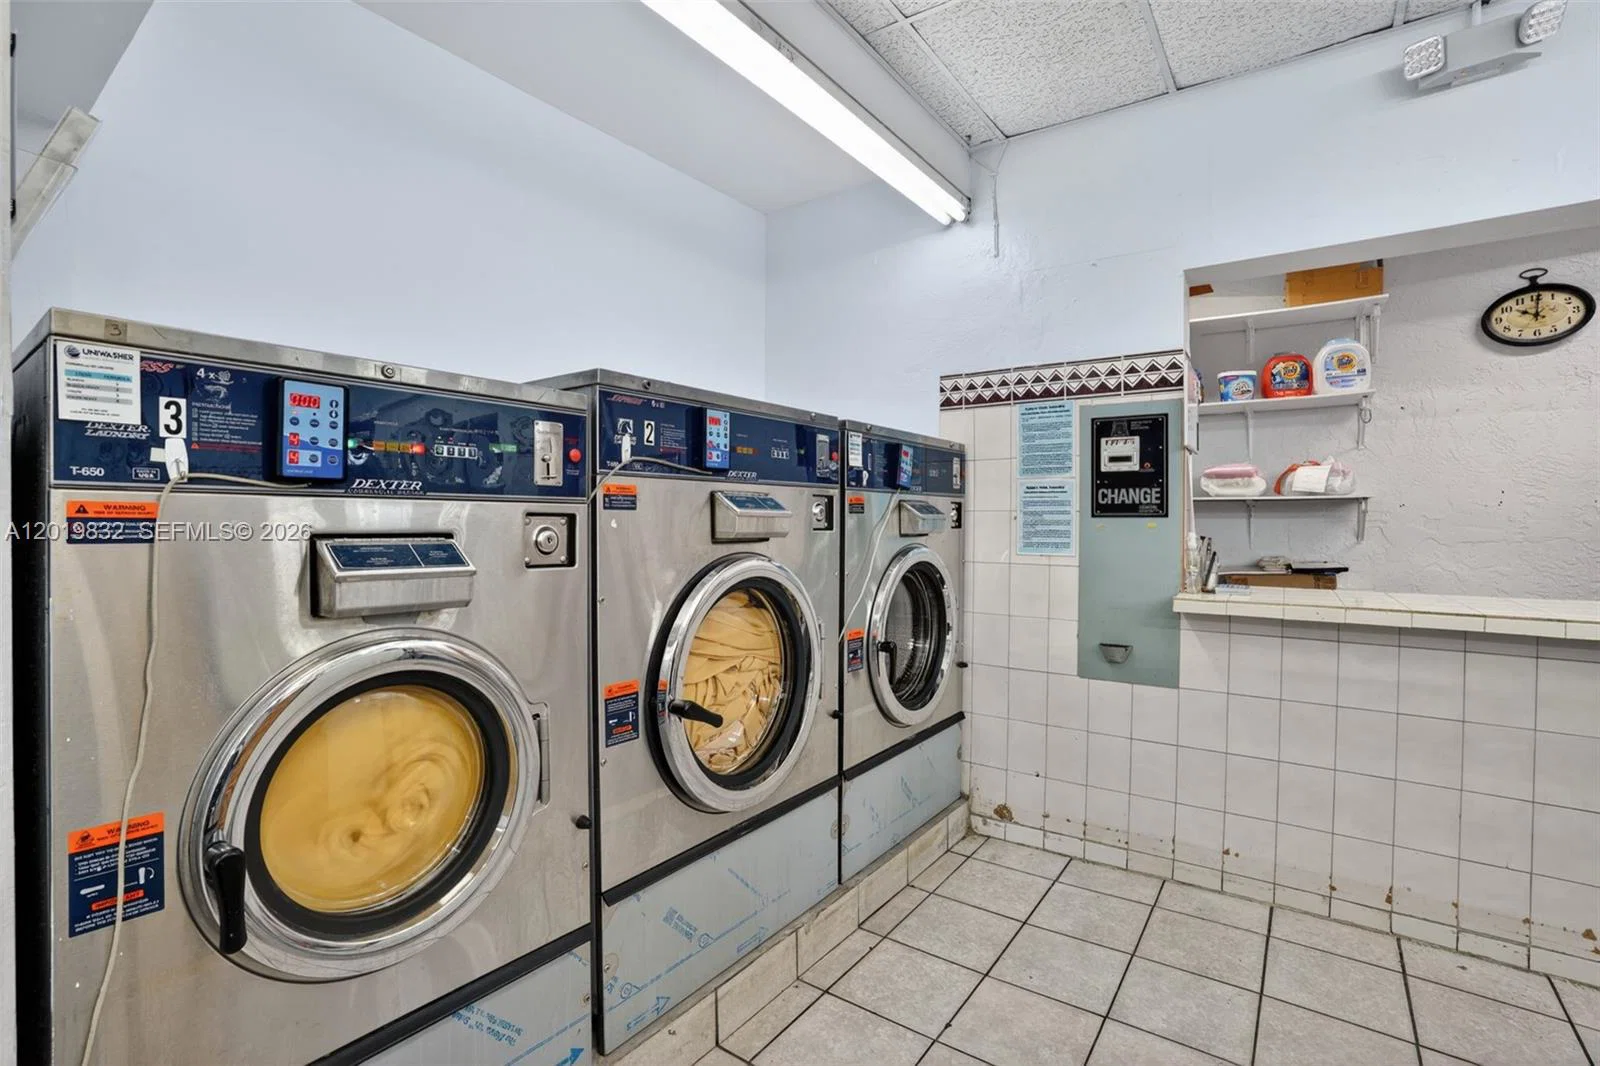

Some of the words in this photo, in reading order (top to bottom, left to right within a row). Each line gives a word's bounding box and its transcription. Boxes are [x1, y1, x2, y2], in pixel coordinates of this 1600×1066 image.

[1516, 297, 1525, 306] 11
[1564, 296, 1572, 305] 2
[1500, 305, 1513, 314] 10
[1572, 305, 1580, 314] 3
[1494, 317, 1503, 325] 9
[110, 323, 122, 336] 3
[1503, 325, 1511, 333] 8
[1533, 328, 1541, 337] 6
[82, 348, 134, 361] UNIWASHER
[197, 367, 205, 378] 4
[163, 400, 183, 435] 3
[646, 422, 653, 444] 2
[70, 466, 105, 477] T-650
[351, 478, 422, 490] DEXTER
[1098, 487, 1160, 504] CHANGE
[107, 820, 150, 834] WANING
